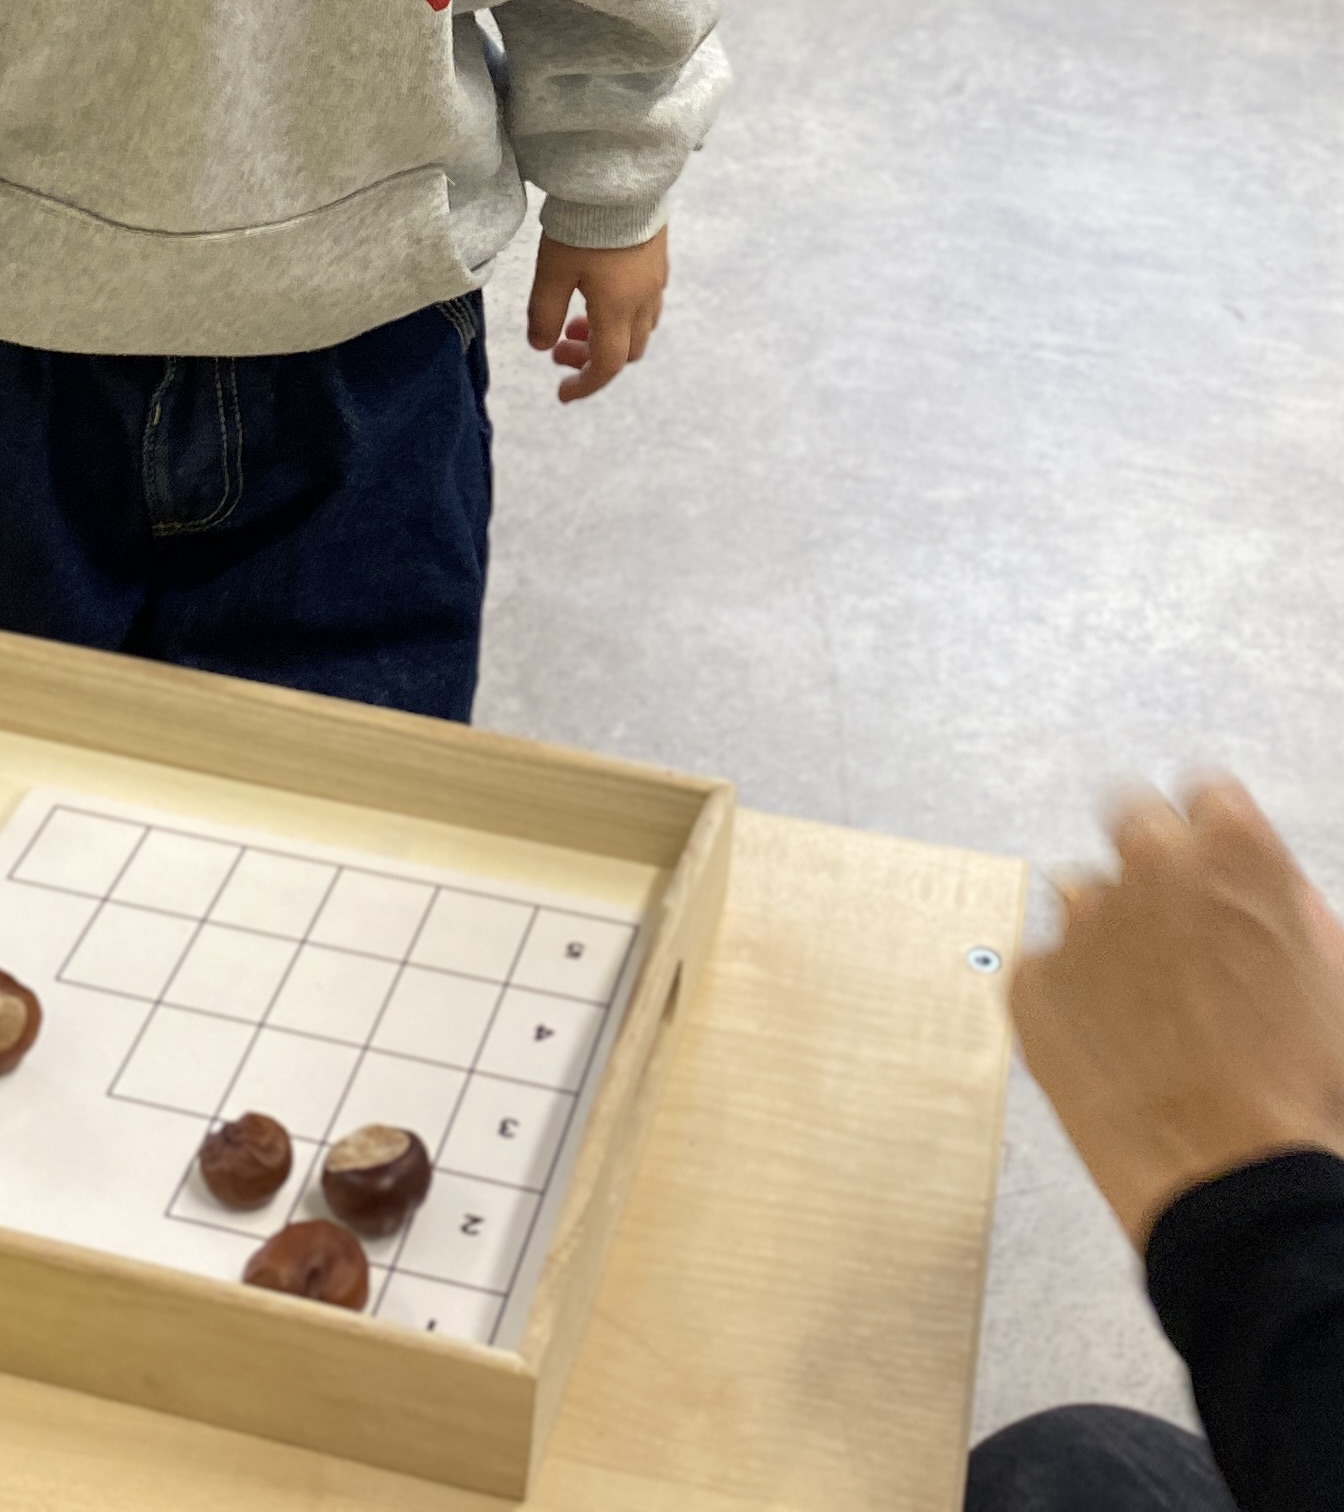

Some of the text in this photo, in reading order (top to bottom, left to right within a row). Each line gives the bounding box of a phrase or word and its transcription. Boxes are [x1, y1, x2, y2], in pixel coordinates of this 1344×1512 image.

[565, 941, 585, 959] 5
[535, 1024, 555, 1042] 4
[498, 1117, 519, 1139] 3
[460, 1213, 484, 1236] 2
